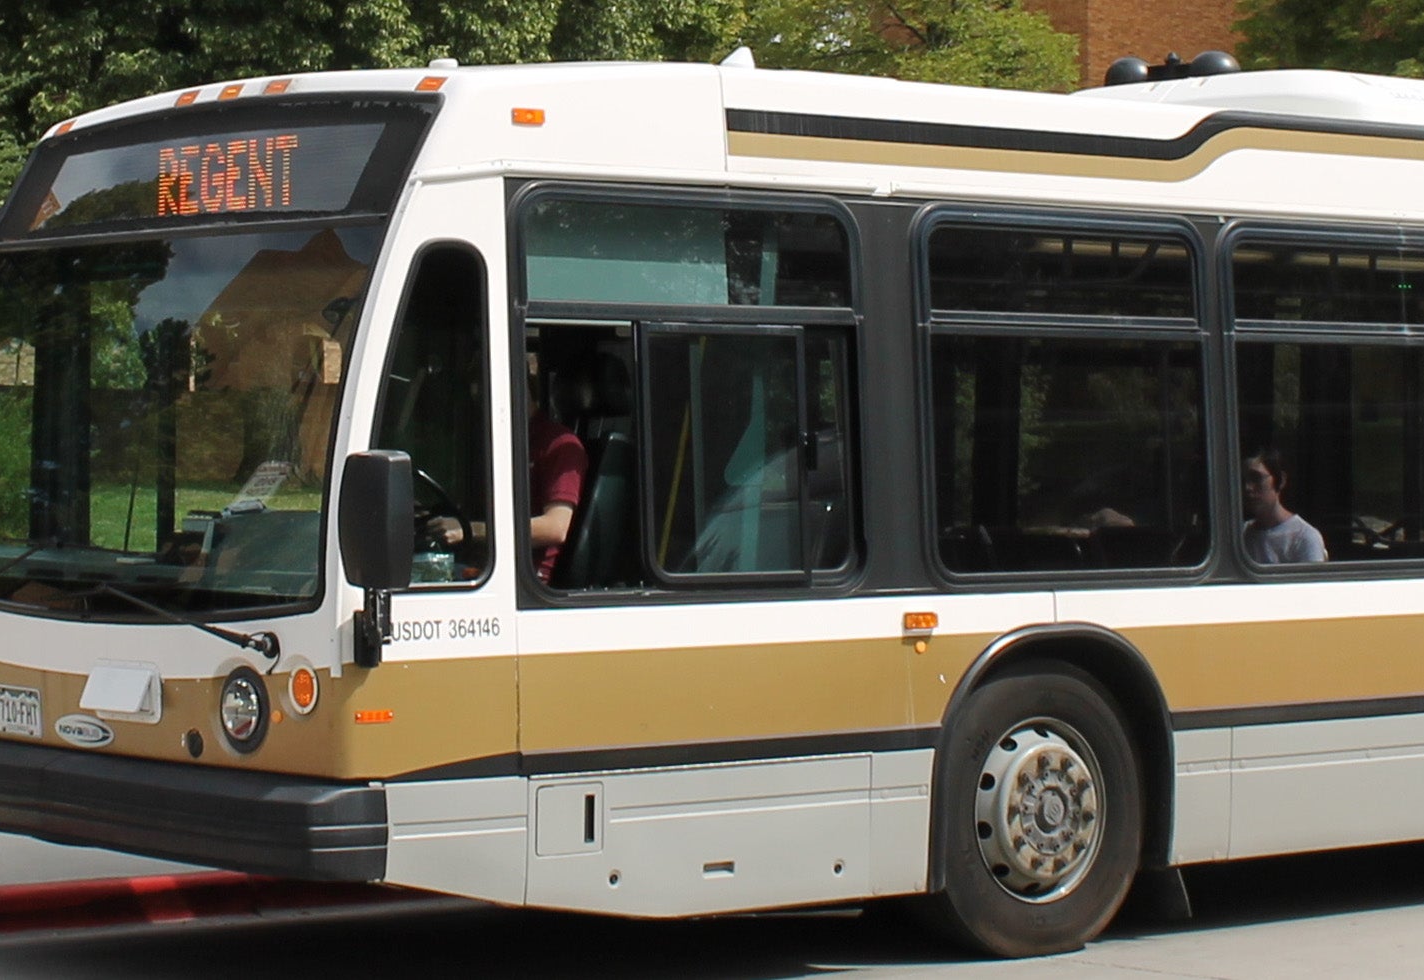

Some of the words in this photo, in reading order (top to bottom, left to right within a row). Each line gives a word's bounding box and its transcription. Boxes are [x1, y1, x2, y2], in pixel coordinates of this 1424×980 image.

[158, 134, 298, 216] REGENT
[390, 620, 442, 641] USDOT
[449, 617, 500, 638] 364146
